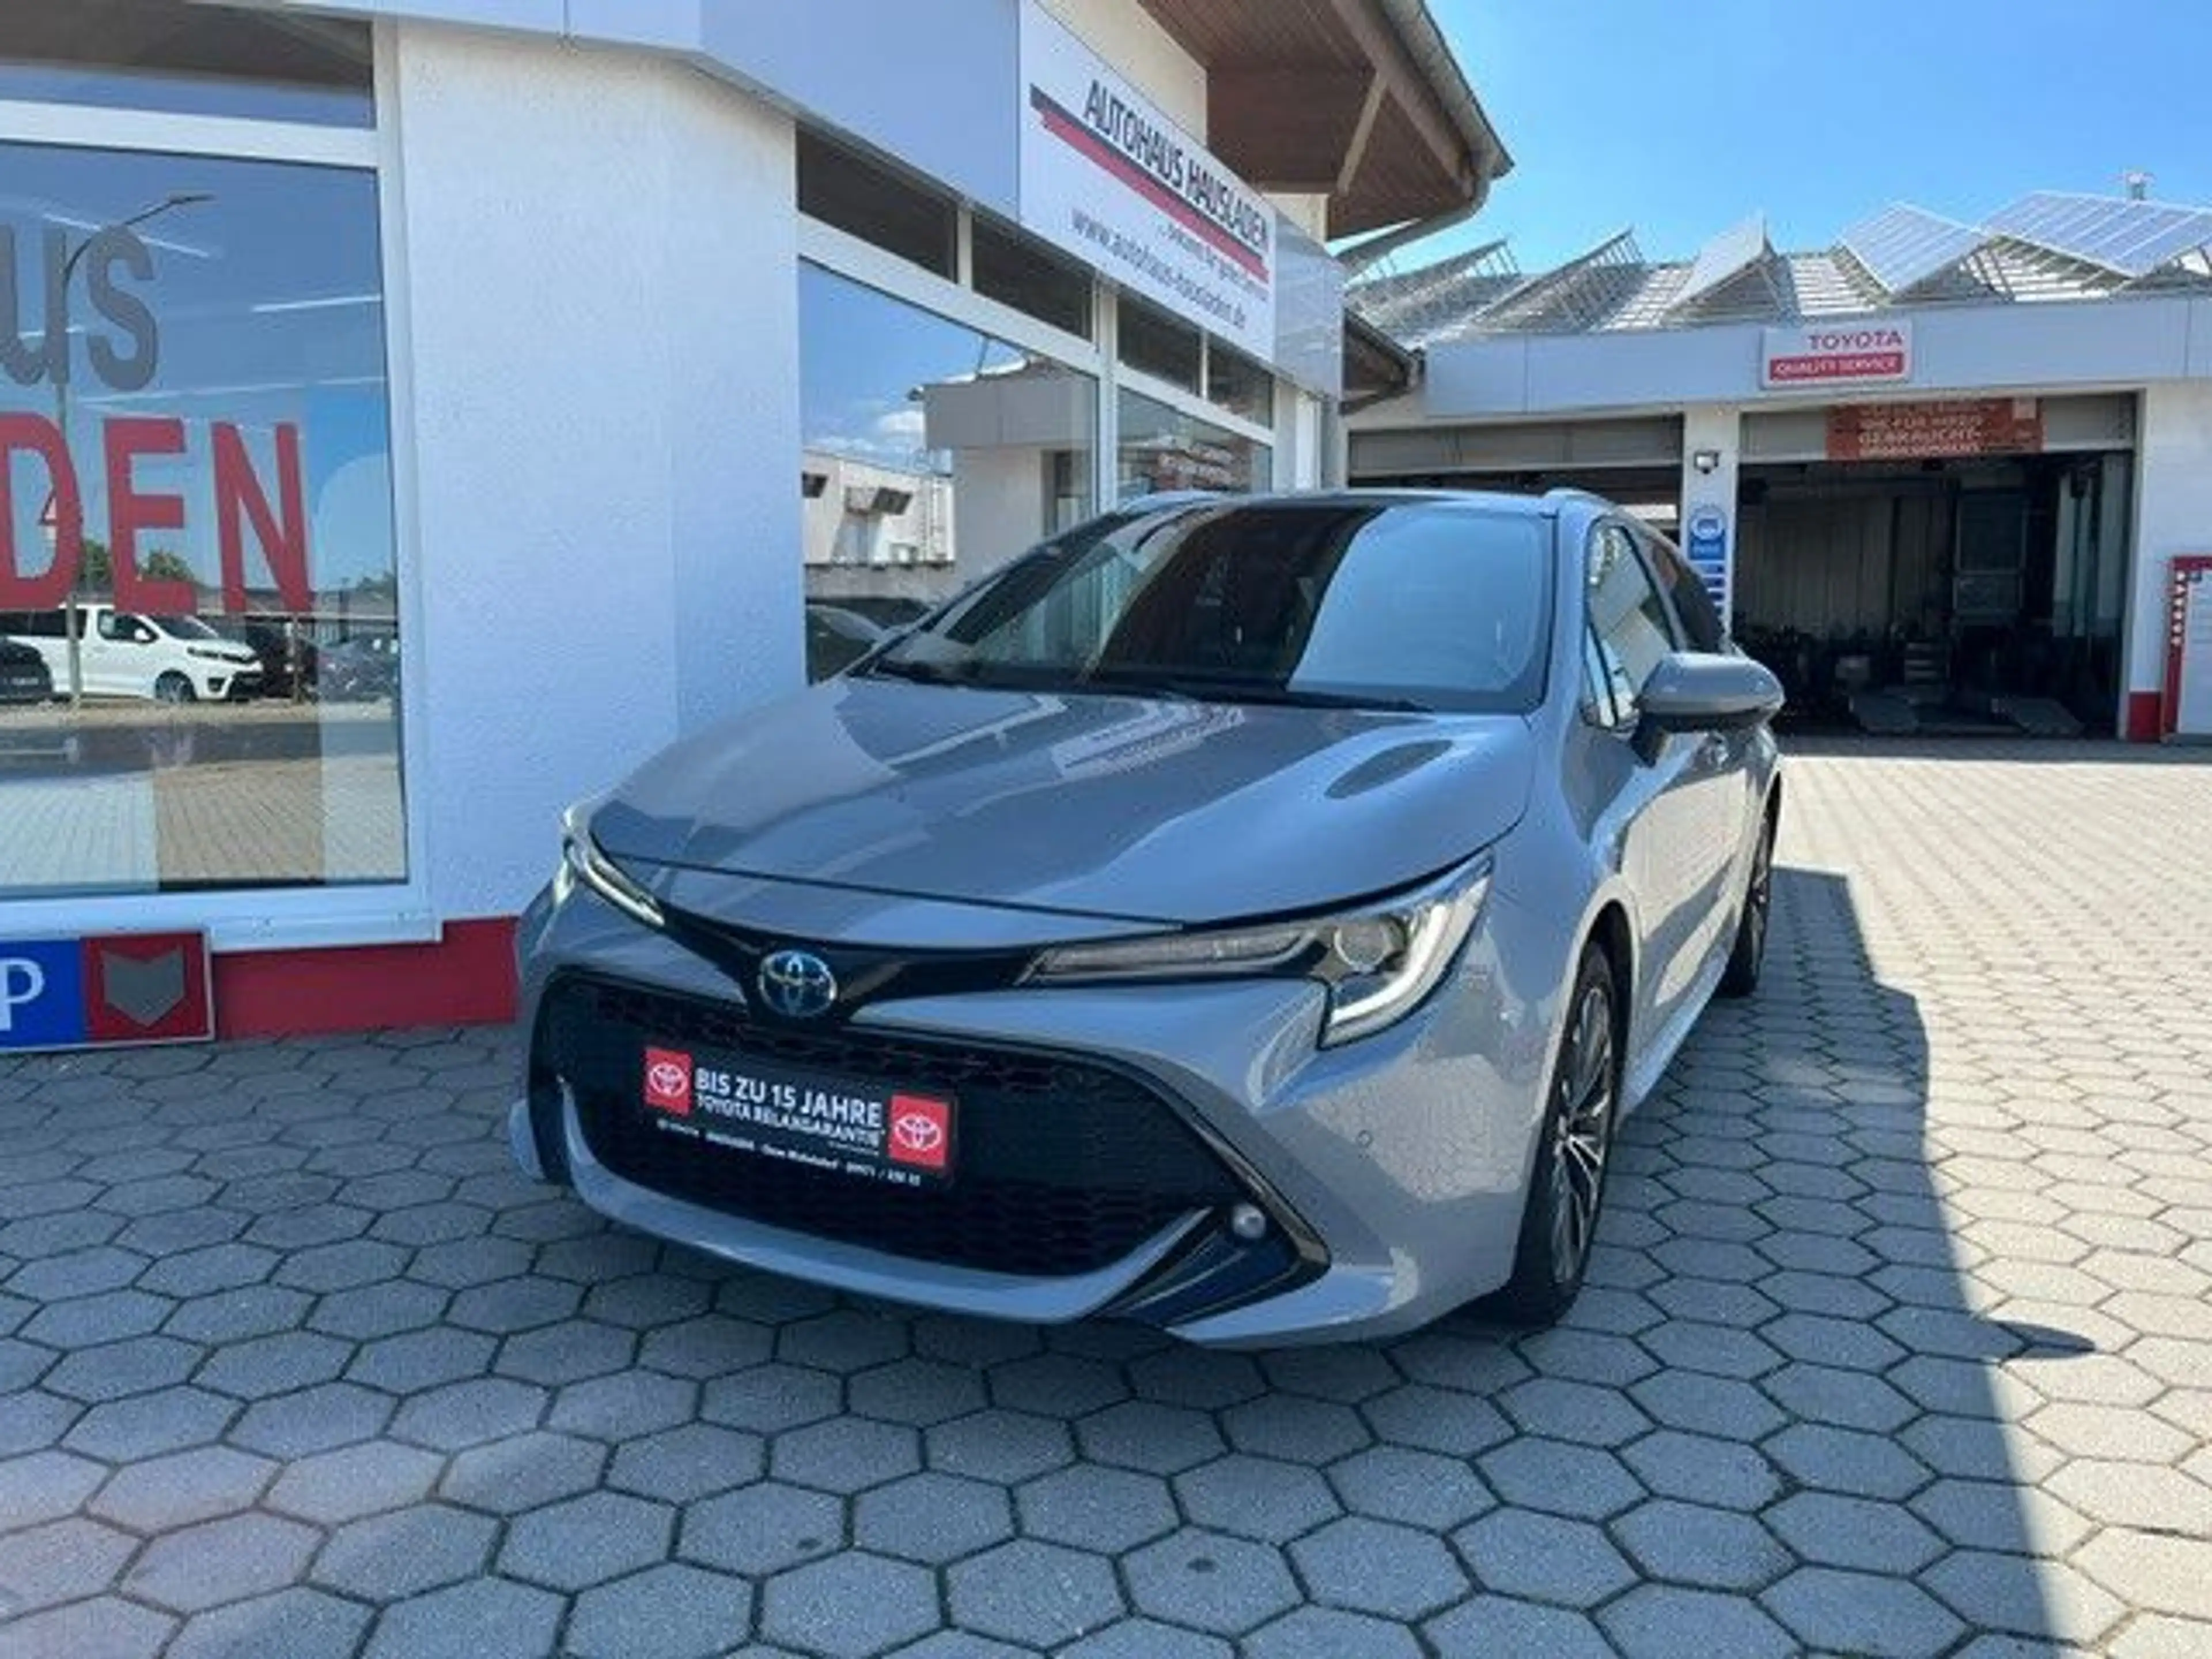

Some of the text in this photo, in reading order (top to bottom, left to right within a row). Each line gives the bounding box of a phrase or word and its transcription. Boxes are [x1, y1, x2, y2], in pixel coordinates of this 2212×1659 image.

[1084, 79, 1266, 246] AUTOHAUS HAUSLADEN
[1772, 355, 1899, 377] QUALITY SERVICE
[1808, 331, 1903, 350] TOYOTA
[0, 411, 315, 616] DEN
[0, 957, 46, 1031] P
[694, 1067, 883, 1128] BIS ZU 15 JAHRE
[694, 1092, 751, 1122] TOYOTA
